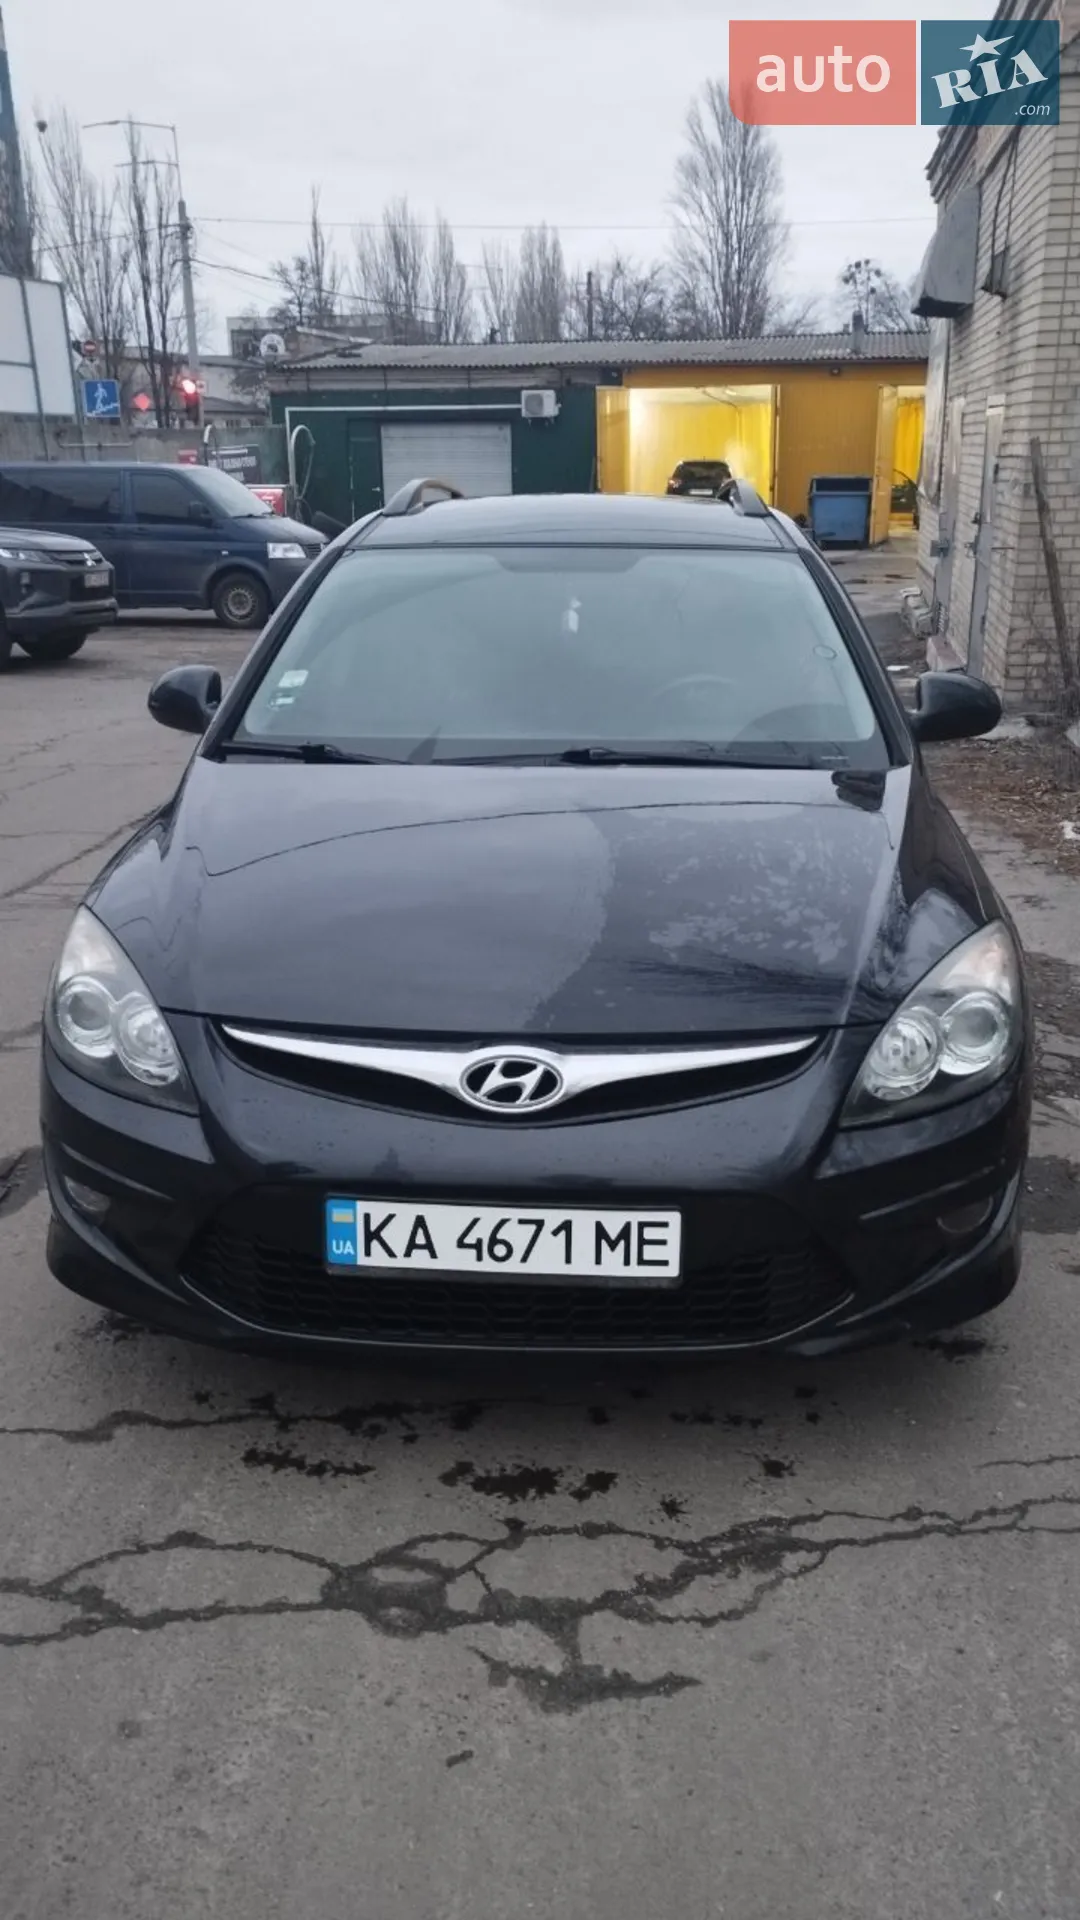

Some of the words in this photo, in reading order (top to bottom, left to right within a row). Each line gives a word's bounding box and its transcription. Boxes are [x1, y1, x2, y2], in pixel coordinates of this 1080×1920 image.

[332, 1240, 355, 1255] UA
[363, 1212, 438, 1259] KA
[456, 1217, 573, 1265] 4671
[594, 1220, 670, 1267] ME
